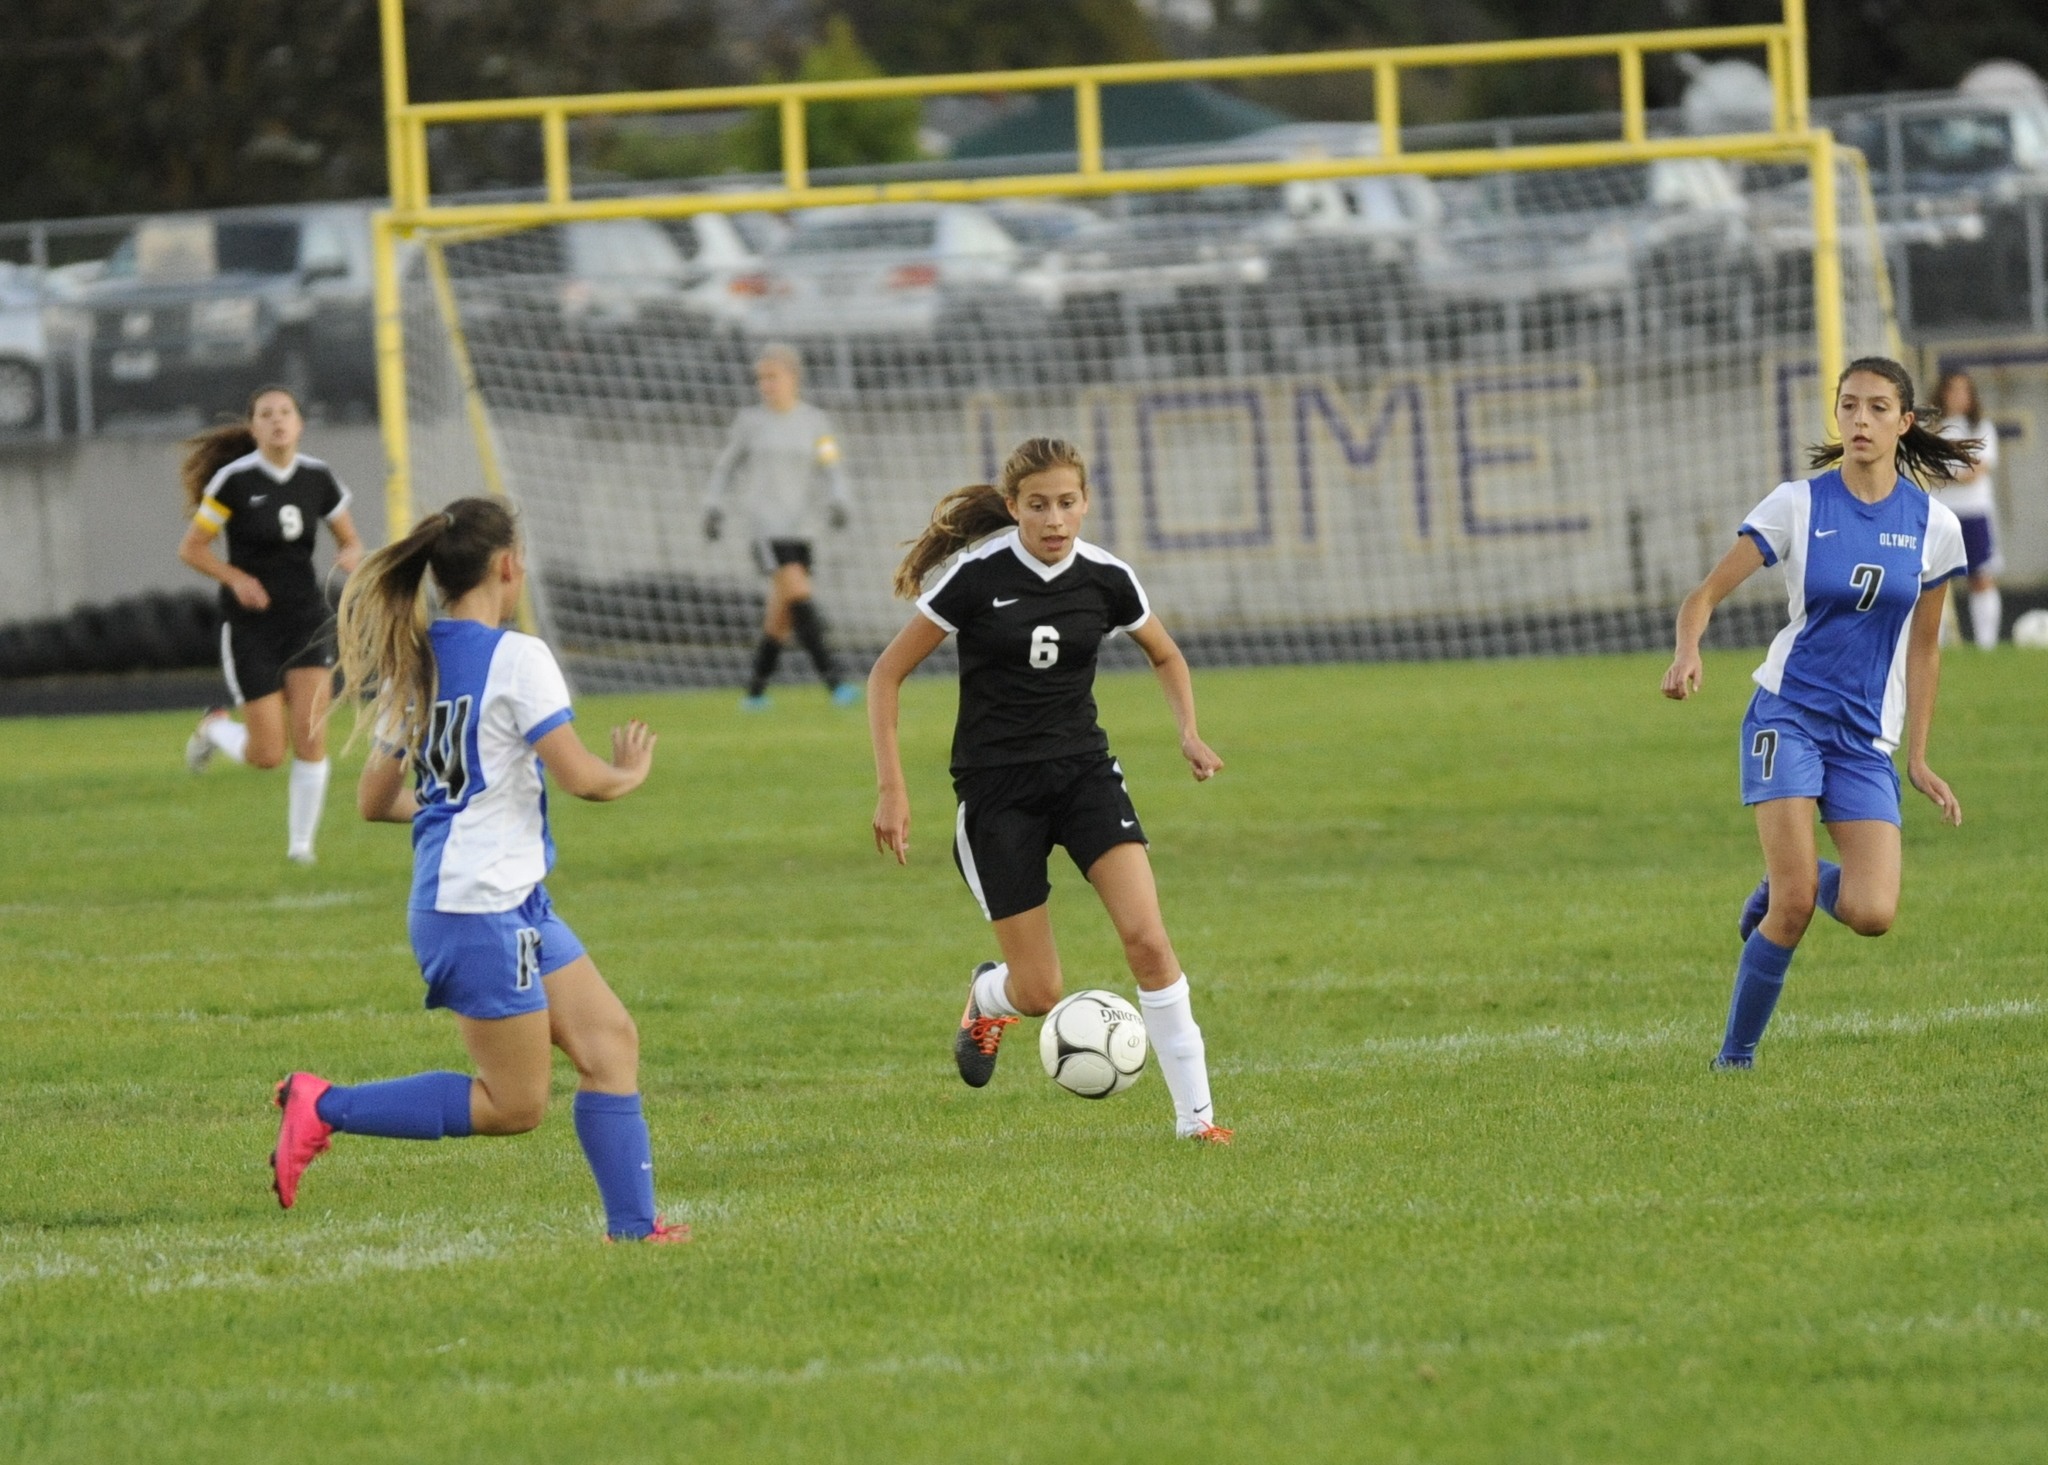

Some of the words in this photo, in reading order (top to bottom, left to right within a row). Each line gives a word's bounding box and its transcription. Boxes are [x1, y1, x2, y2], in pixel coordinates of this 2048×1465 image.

[278, 504, 304, 541] 9
[1879, 532, 1917, 550] OLYMPIC
[1850, 563, 1885, 611] 7
[1029, 625, 1060, 669] 6
[1752, 729, 1778, 780] 7
